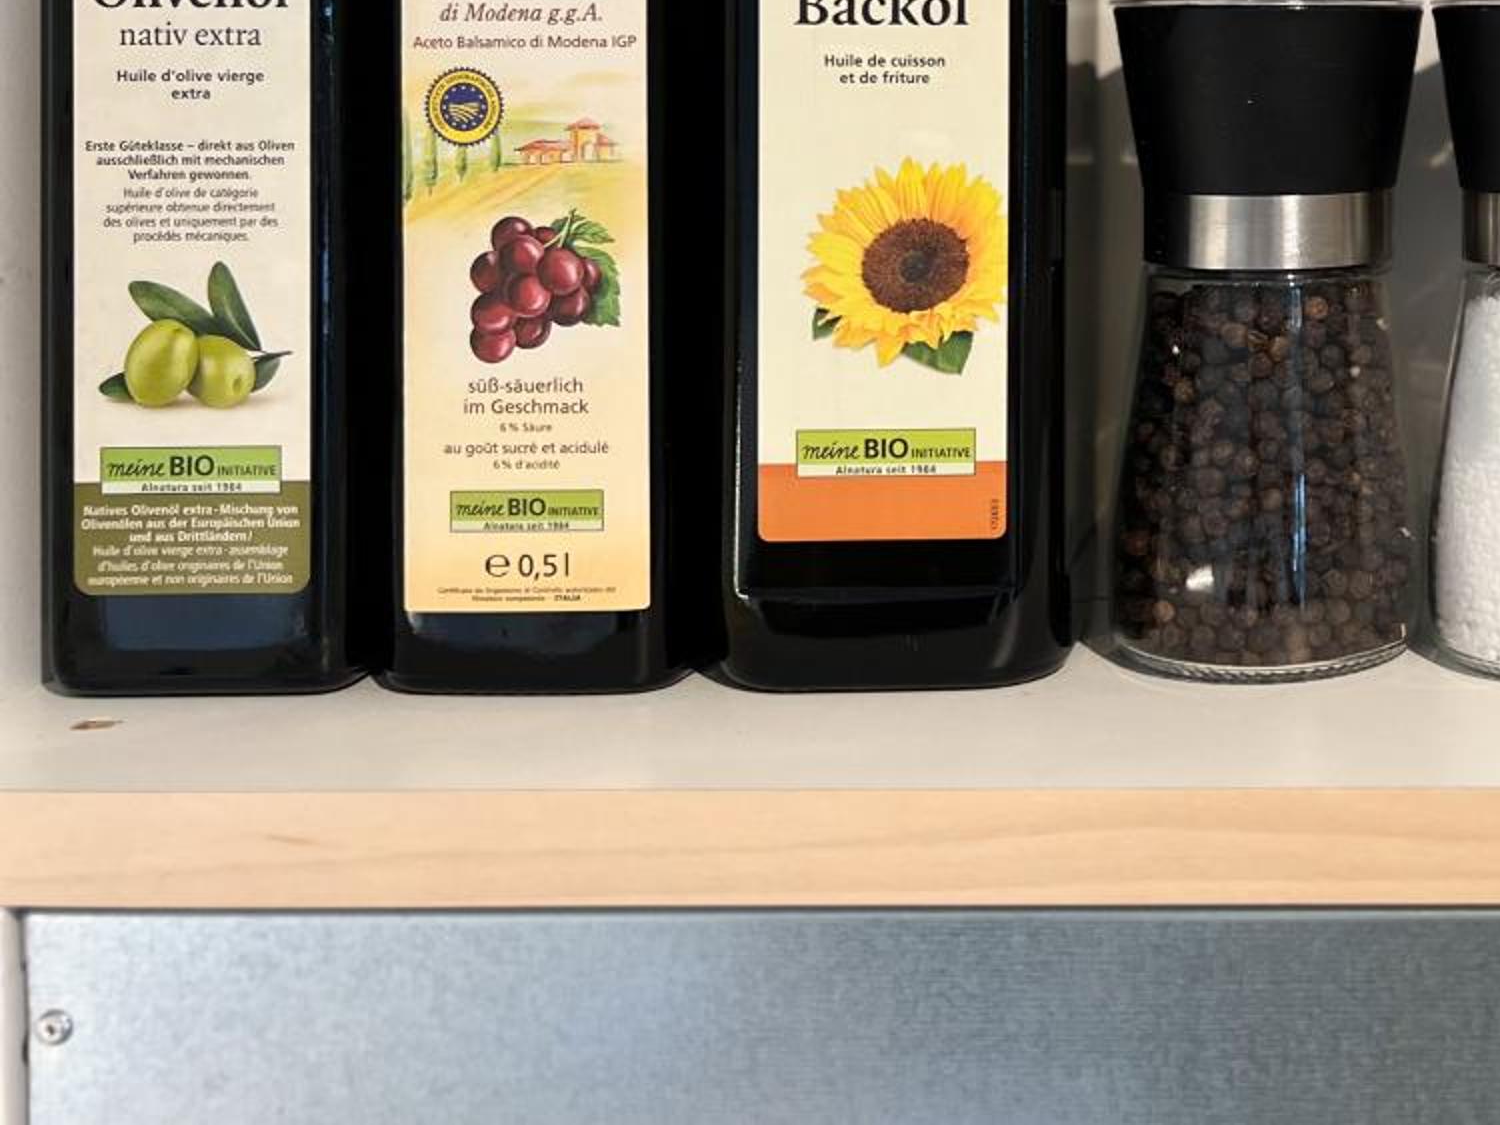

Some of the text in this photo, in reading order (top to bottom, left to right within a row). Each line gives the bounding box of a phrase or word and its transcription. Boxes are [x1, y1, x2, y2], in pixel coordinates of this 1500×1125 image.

[440, 3, 603, 25] di Modena g.g.A.
[120, 21, 261, 46] nativ extra
[413, 36, 637, 48] Aceto Balsamico di Modena IGP
[824, 54, 945, 67] Huile de cuisson
[117, 70, 264, 85] Huile d'olive vierge
[839, 71, 930, 85] et de friture
[171, 88, 211, 100] extra
[85, 140, 115, 152] Erste
[119, 140, 184, 152] Güteklasse
[197, 139, 231, 151] direkt
[235, 142, 254, 151] aus
[258, 140, 295, 151] Oliven
[181, 154, 201, 165] mit
[204, 154, 285, 165] mechanischen
[127, 168, 186, 180] Verfahren
[124, 187, 152, 198] Huile
[194, 187, 207, 198] de
[125, 217, 156, 227] olives
[160, 218, 171, 227] et
[468, 377, 583, 394] süß-säuerlich
[463, 399, 589, 415] im Geschmack
[444, 441, 609, 457] au goût sucré et acidulé
[802, 438, 970, 460] meine BIO INITIATIVE
[108, 455, 277, 477] meine BIO INITIATIVE
[836, 466, 883, 475] Alnatura
[886, 465, 907, 474] seit
[141, 482, 189, 492] Alnatura
[192, 483, 213, 492] seit
[456, 498, 600, 517] meine BIO INITIATIVE
